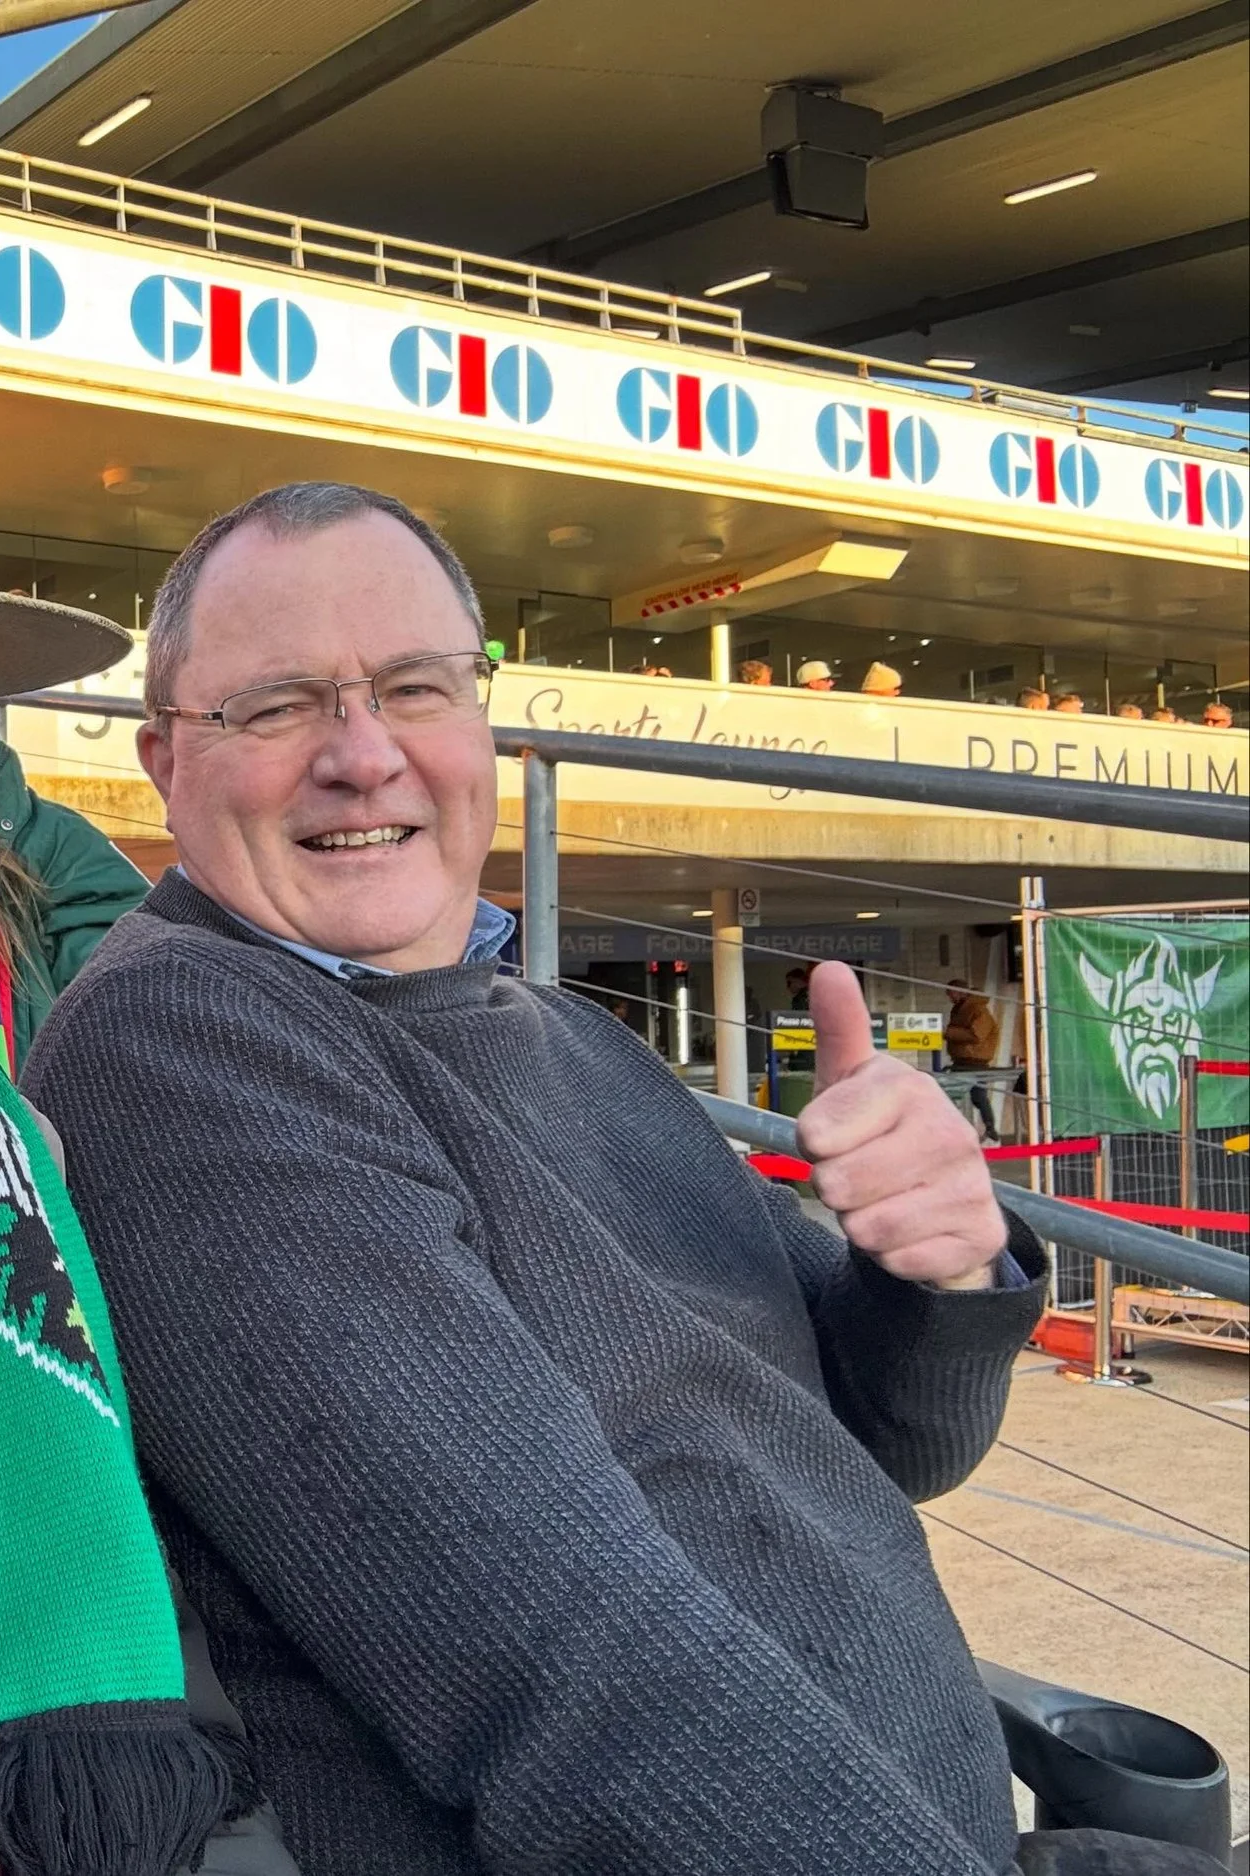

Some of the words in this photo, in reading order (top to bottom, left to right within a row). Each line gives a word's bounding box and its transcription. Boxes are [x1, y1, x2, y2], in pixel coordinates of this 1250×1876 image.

[131, 275, 316, 383] GIO
[390, 326, 551, 424] GIO
[617, 368, 758, 456] GIO
[816, 403, 939, 484] GIO
[990, 433, 1100, 508] GIO
[1145, 459, 1243, 529] GIO
[753, 933, 883, 955] BEVERAGE
